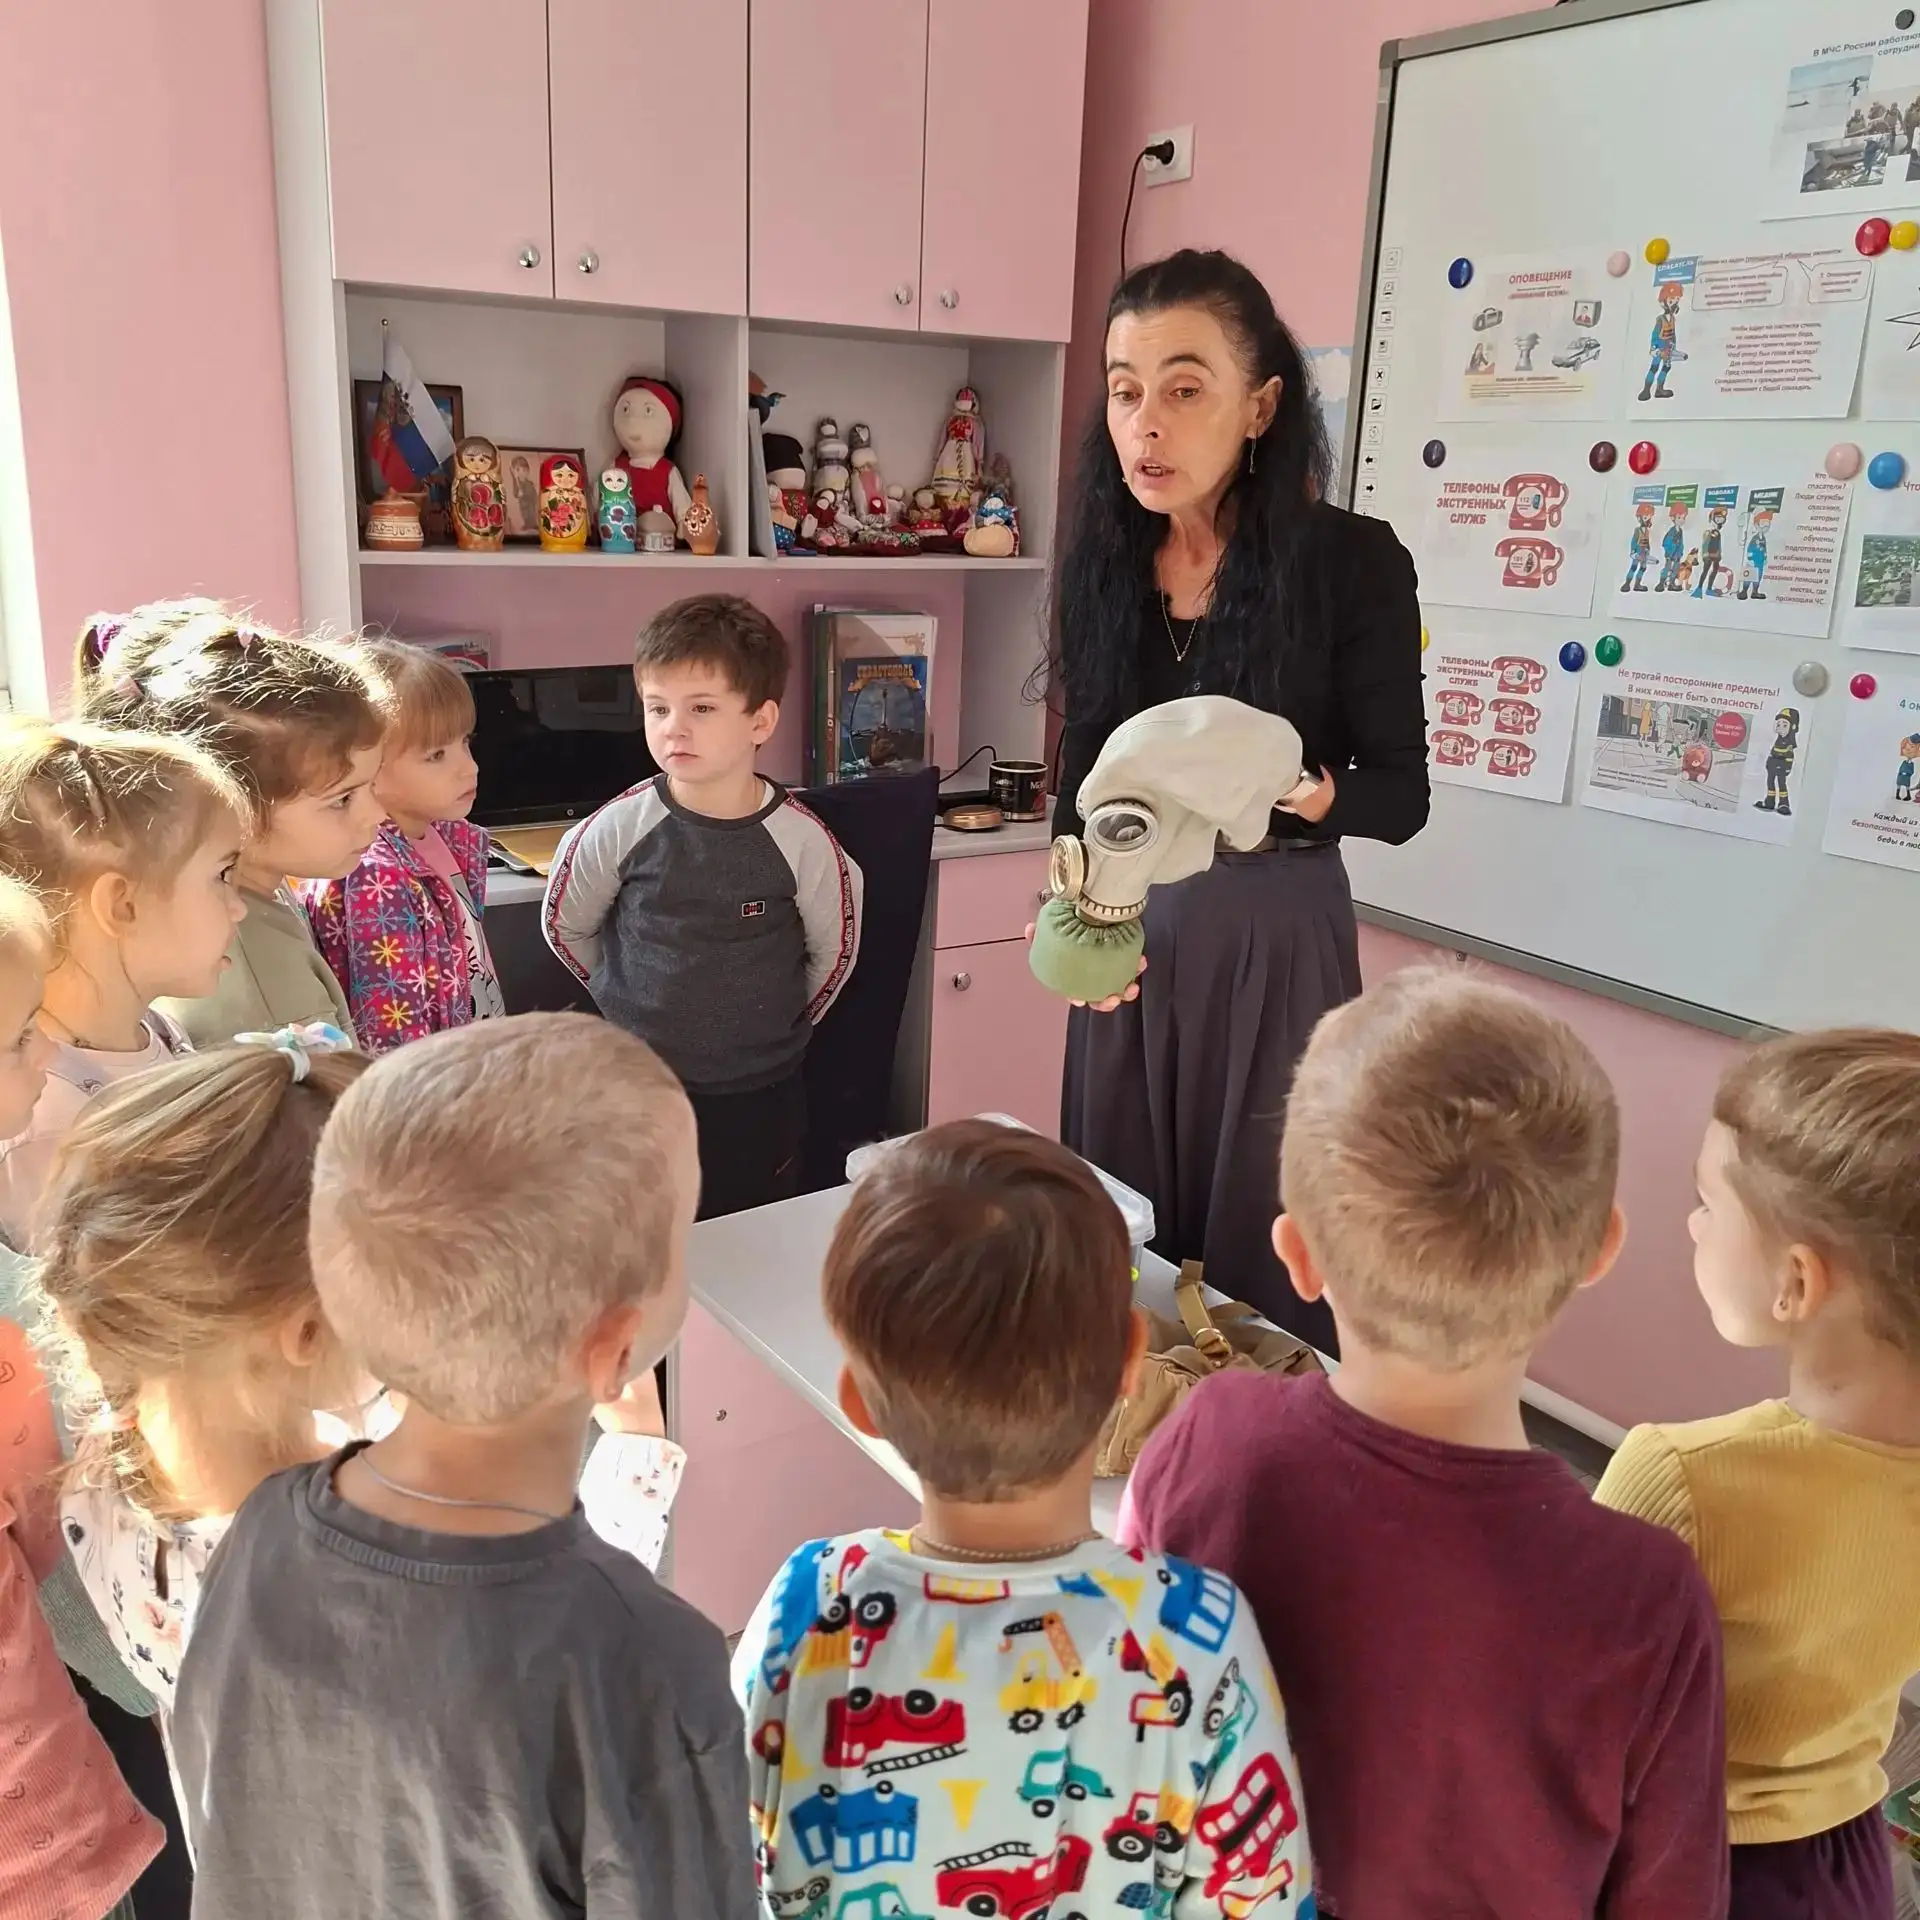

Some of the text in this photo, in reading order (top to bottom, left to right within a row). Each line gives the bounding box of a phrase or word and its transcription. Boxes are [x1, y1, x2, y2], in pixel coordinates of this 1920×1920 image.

[1813, 49, 1820, 57] В
[1822, 46, 1841, 55] МЧС
[1844, 41, 1876, 51] России
[1509, 270, 1572, 284] ОПОВЕЩЕНИЕ
[1443, 482, 1501, 493] ТЕЛЕФОНЫ
[1904, 481, 1920, 491] Что
[1436, 498, 1507, 509] ЭКСТРЕННЫХ
[1816, 494, 1844, 502] службы
[1450, 513, 1486, 524] СЛУЖБ
[1441, 656, 1490, 667] ТЕЛЕФОНЫ
[1437, 666, 1495, 678] ЭКСТРЕННЫХ
[1448, 677, 1479, 686] СЛУЖБ
[1618, 668, 1781, 697] Не трогай посторонние предметы!
[1628, 684, 1764, 711] В них может быть опасность!
[1900, 699, 1905, 708] 4
[1874, 812, 1908, 824] Каждый
[1852, 819, 1909, 836] безопасности,
[1877, 835, 1898, 845] беды
